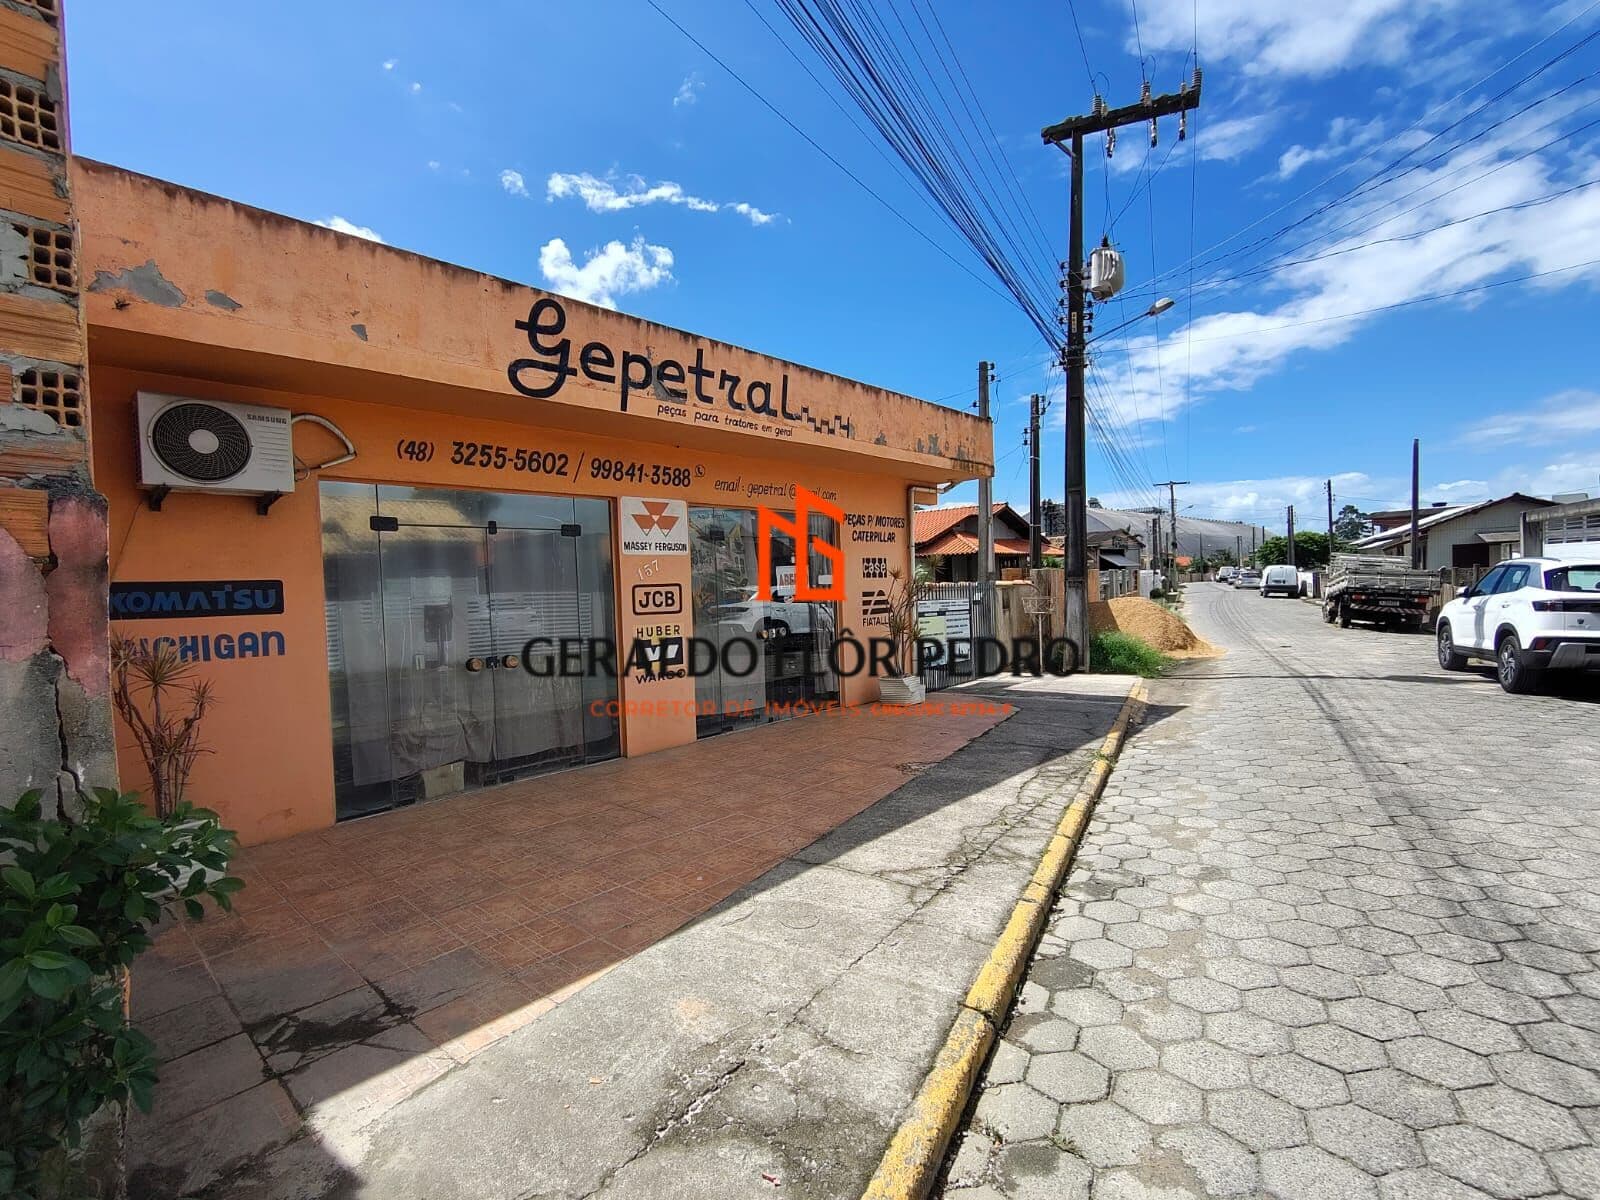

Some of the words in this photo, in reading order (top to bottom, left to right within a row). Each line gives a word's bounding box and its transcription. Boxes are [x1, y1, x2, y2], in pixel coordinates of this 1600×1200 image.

[246, 413, 287, 424] SAMSUNG
[657, 404, 688, 417] peças
[694, 410, 720, 424] para
[725, 415, 759, 430] tratores
[762, 424, 773, 433] em
[774, 426, 793, 437] geral
[396, 439, 435, 462] (48)
[450, 441, 569, 477] 3255-5602
[590, 458, 692, 488] 99841-3588
[842, 513, 866, 527] PEÇAS
[875, 517, 905, 529] MOTORES
[852, 530, 896, 543] CATERPILLAR
[623, 541, 653, 551] MASSEY
[655, 542, 687, 552] FERGUSON
[638, 559, 659, 580] 157
[110, 584, 277, 613] KOMATSU
[638, 591, 676, 608] JCB
[636, 625, 681, 637] HUBER
